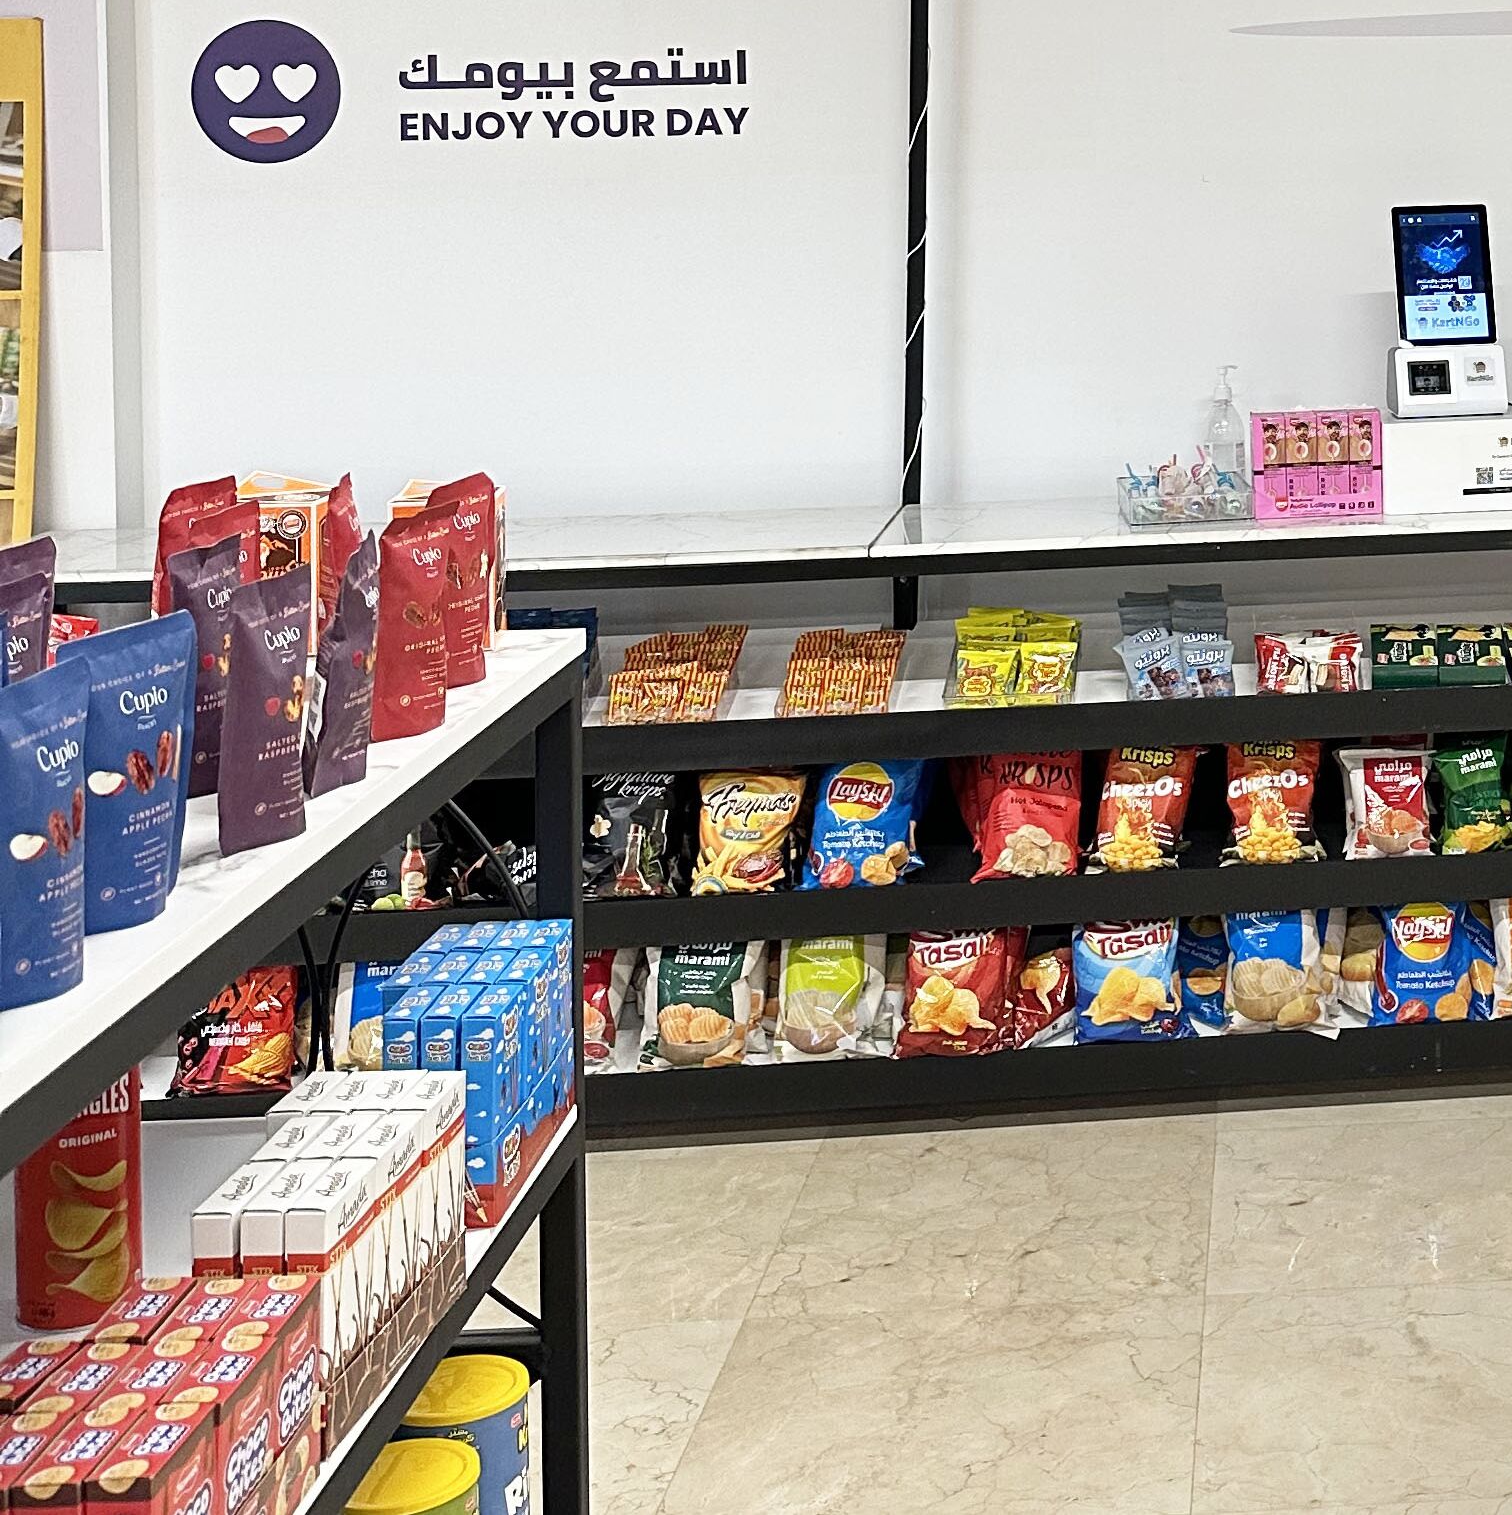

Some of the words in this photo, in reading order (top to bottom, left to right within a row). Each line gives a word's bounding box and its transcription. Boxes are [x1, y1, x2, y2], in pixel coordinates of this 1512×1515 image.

[398, 51, 575, 102] بيومك
[588, 47, 748, 102] استمع
[400, 111, 535, 143] ENJOY
[541, 110, 658, 140] YOUR
[666, 107, 750, 137] DAY
[1120, 746, 1176, 768] Krisps
[1242, 740, 1295, 759] Krisps
[1460, 759, 1497, 775] marami
[831, 780, 870, 803] Lay's
[674, 952, 731, 967] marami
[58, 1127, 118, 1149] ORIGINAL
